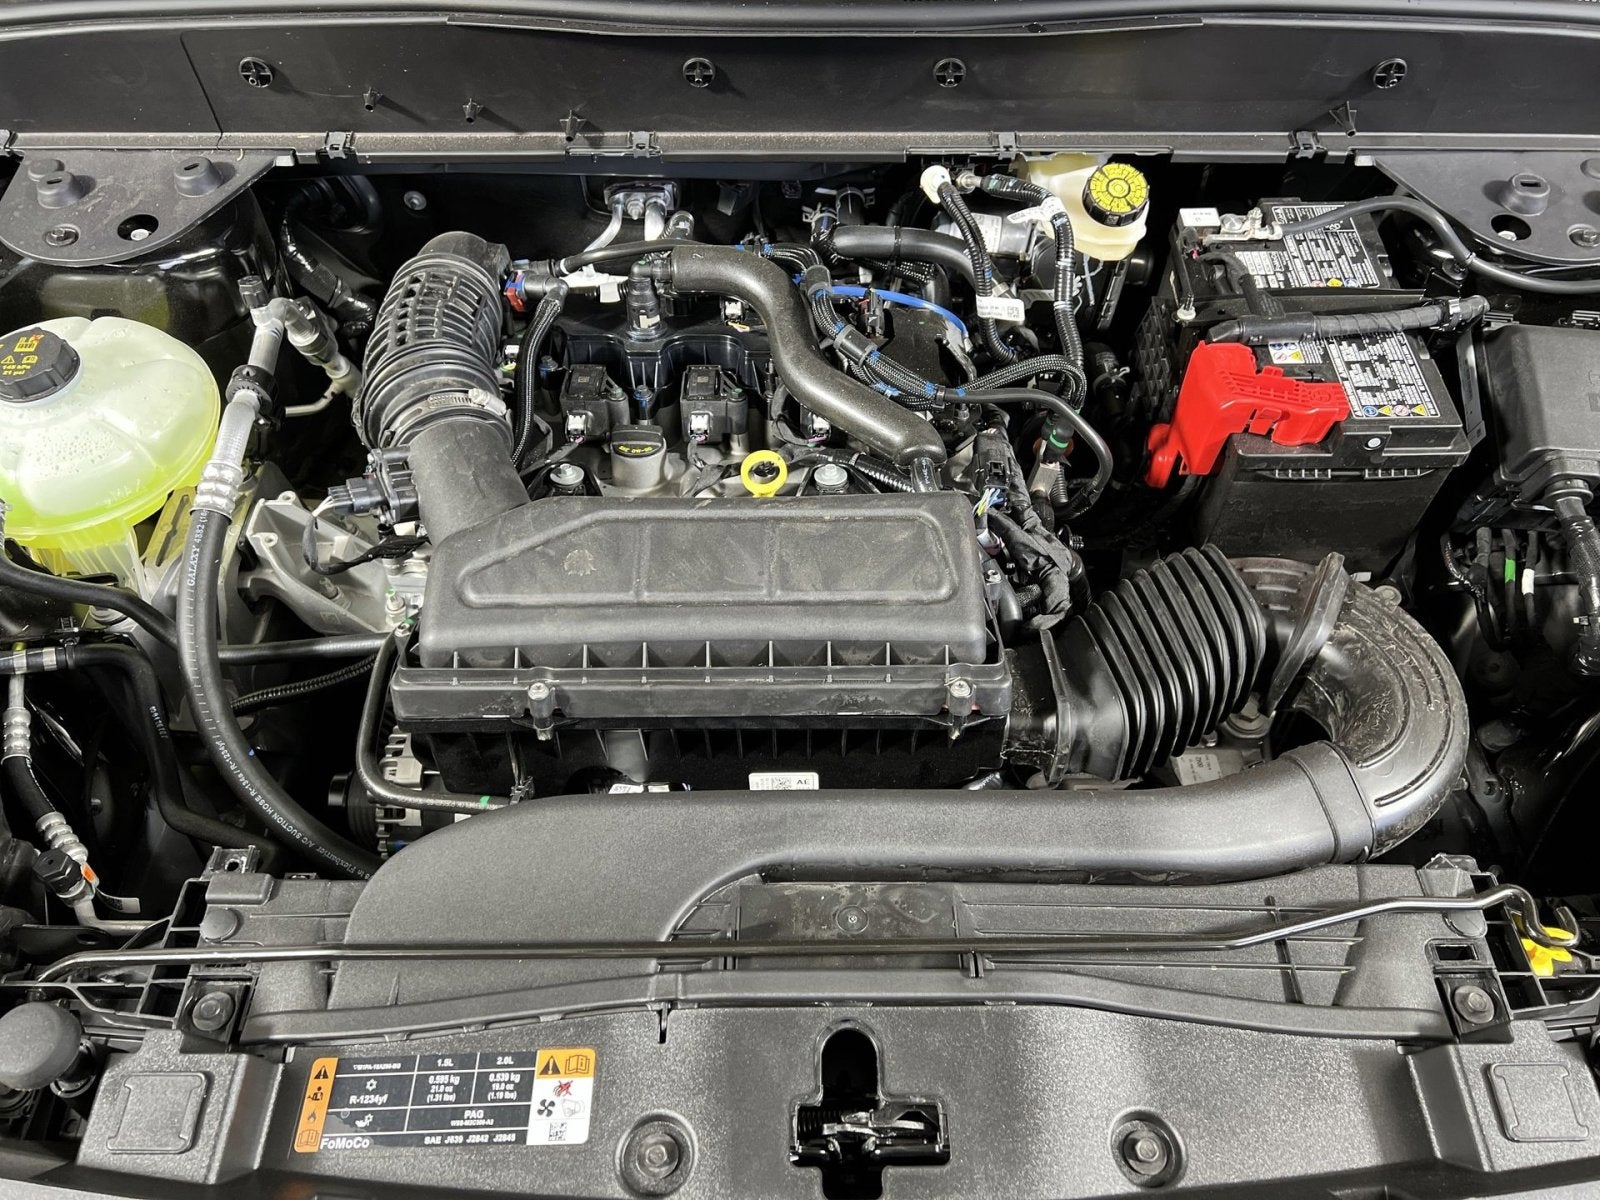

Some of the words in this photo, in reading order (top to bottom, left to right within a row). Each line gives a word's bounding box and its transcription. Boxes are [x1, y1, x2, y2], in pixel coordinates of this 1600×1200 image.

[187, 544, 200, 587] GALAXY
[215, 740, 238, 770] R-1234yf
[255, 795, 274, 814] HOSE
[272, 812, 302, 839] SUCTION
[302, 837, 316, 848] A/C
[316, 845, 357, 874] Flexbarrier
[437, 1058, 454, 1067] 1.5L
[496, 1056, 514, 1065] 2.0L
[449, 1074, 461, 1086] kg
[510, 1072, 521, 1083] kg
[349, 1093, 389, 1106] R-1234yf
[464, 1109, 484, 1119] PAG
[320, 1136, 370, 1150] FoMoCo
[424, 1136, 441, 1145] SAE
